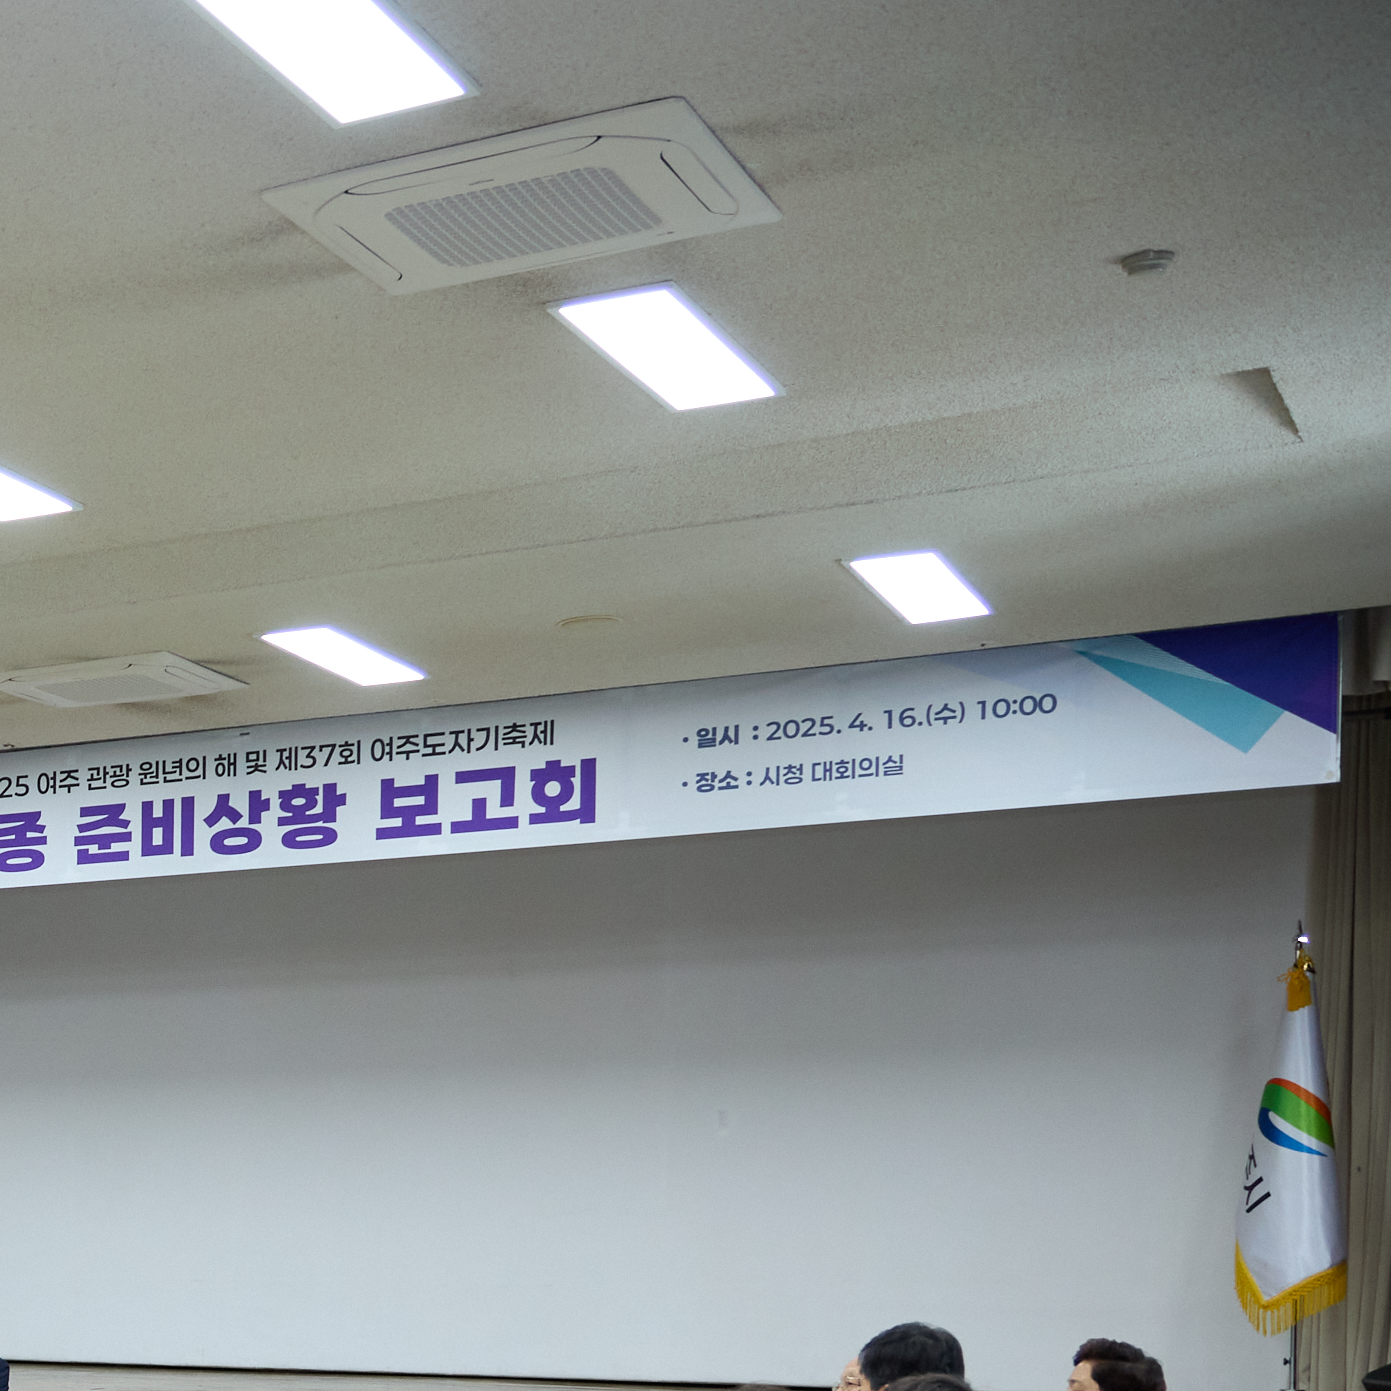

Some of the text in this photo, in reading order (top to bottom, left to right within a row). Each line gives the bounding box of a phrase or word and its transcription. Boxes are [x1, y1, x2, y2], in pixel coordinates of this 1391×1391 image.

[696, 724, 740, 749] 일시
[765, 716, 842, 741] 2025.
[848, 712, 873, 732] 4.
[883, 701, 966, 730] 16.(수)
[976, 693, 1058, 721] 10:00
[37, 769, 80, 794] 여주
[86, 763, 132, 791] 관광
[138, 755, 207, 786] 원년의
[214, 752, 237, 778] 해
[245, 750, 268, 775] 및
[275, 740, 361, 771] 제37회
[370, 719, 555, 762] 여주도자기축제
[695, 770, 739, 793] 장소
[759, 763, 804, 788] 시청
[811, 754, 905, 782] 대회의실
[74, 782, 347, 865] 준비상황
[375, 758, 597, 840] 보고회
